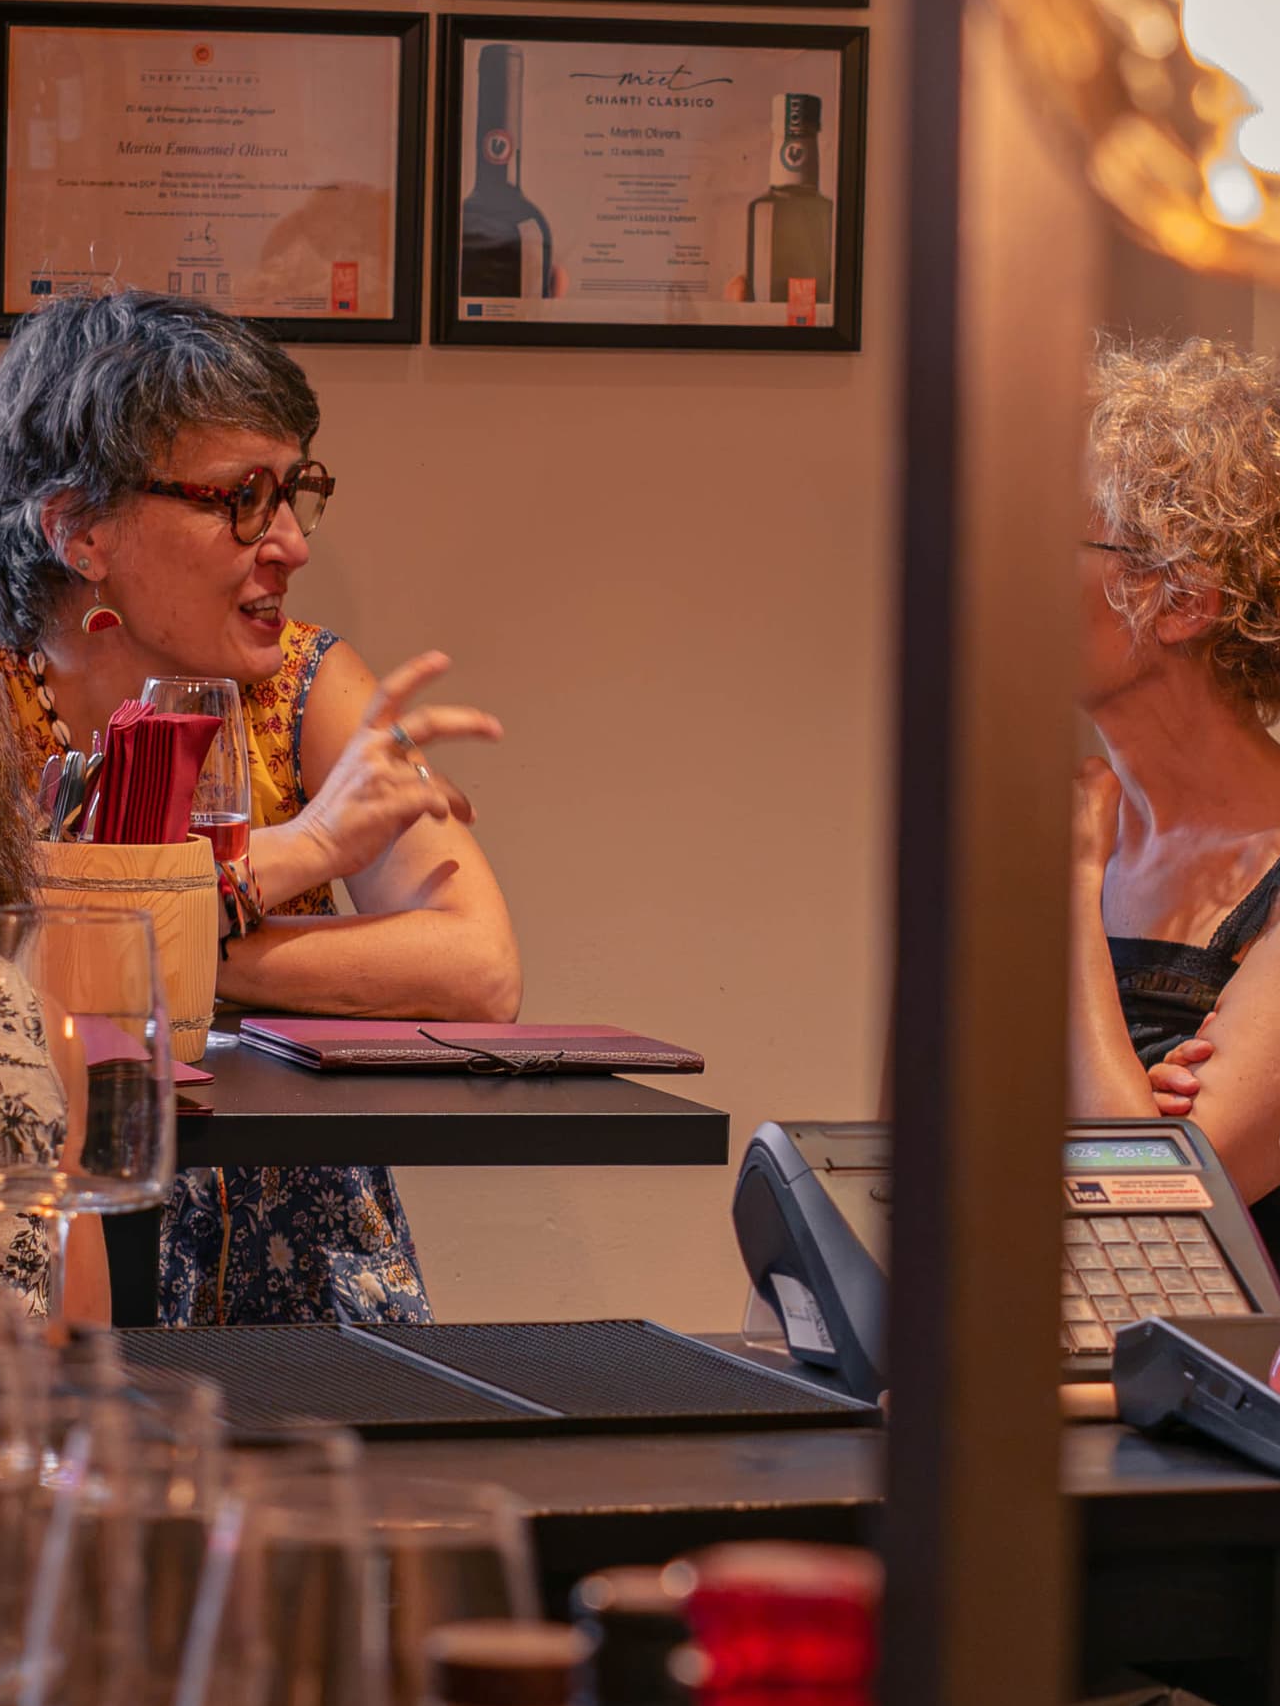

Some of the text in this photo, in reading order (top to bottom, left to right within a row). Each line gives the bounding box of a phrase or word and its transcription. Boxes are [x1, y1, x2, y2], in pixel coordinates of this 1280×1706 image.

[584, 94, 715, 109] CHIANTI CLASSICO
[165, 141, 238, 158] Emmanuel
[238, 143, 289, 158] Olivera
